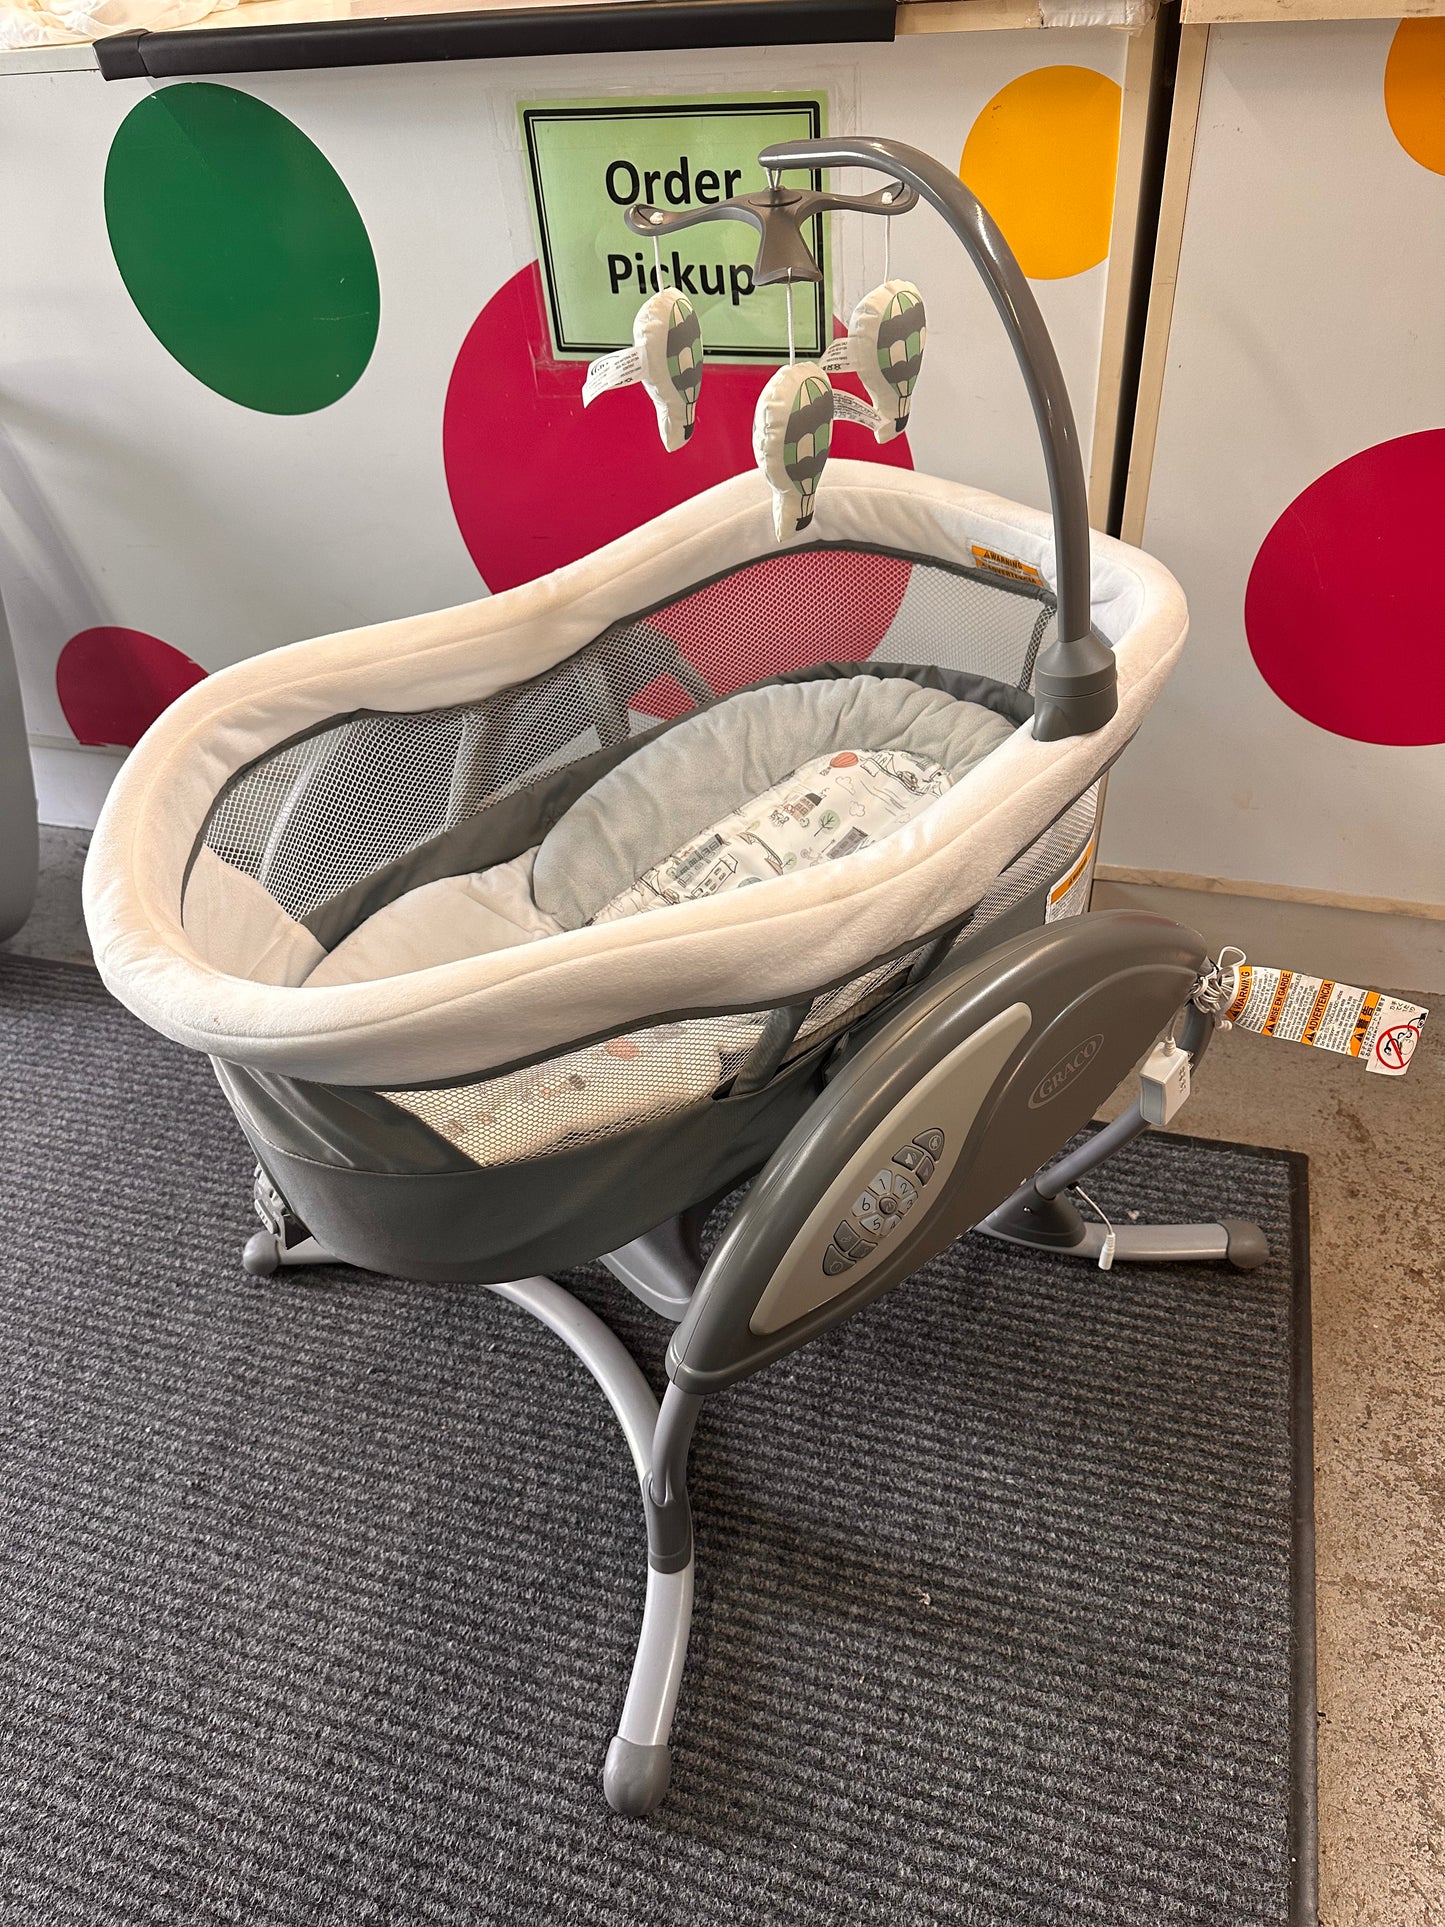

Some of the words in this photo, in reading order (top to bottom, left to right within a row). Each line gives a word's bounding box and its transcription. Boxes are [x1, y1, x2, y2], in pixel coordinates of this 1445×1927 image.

[605, 156, 742, 206] Order
[607, 251, 756, 306] Pickup
[989, 552, 1023, 570] WARNING
[1277, 972, 1291, 995] GARDE
[1274, 996, 1283, 1006] EN
[1308, 981, 1333, 1031] ADVERTENCIA
[1268, 1005, 1280, 1023] MISE
[1039, 1040, 1097, 1099] GRACO
[900, 1182, 909, 1195] 2
[861, 1197, 871, 1211] 6
[873, 1217, 881, 1231] 5
